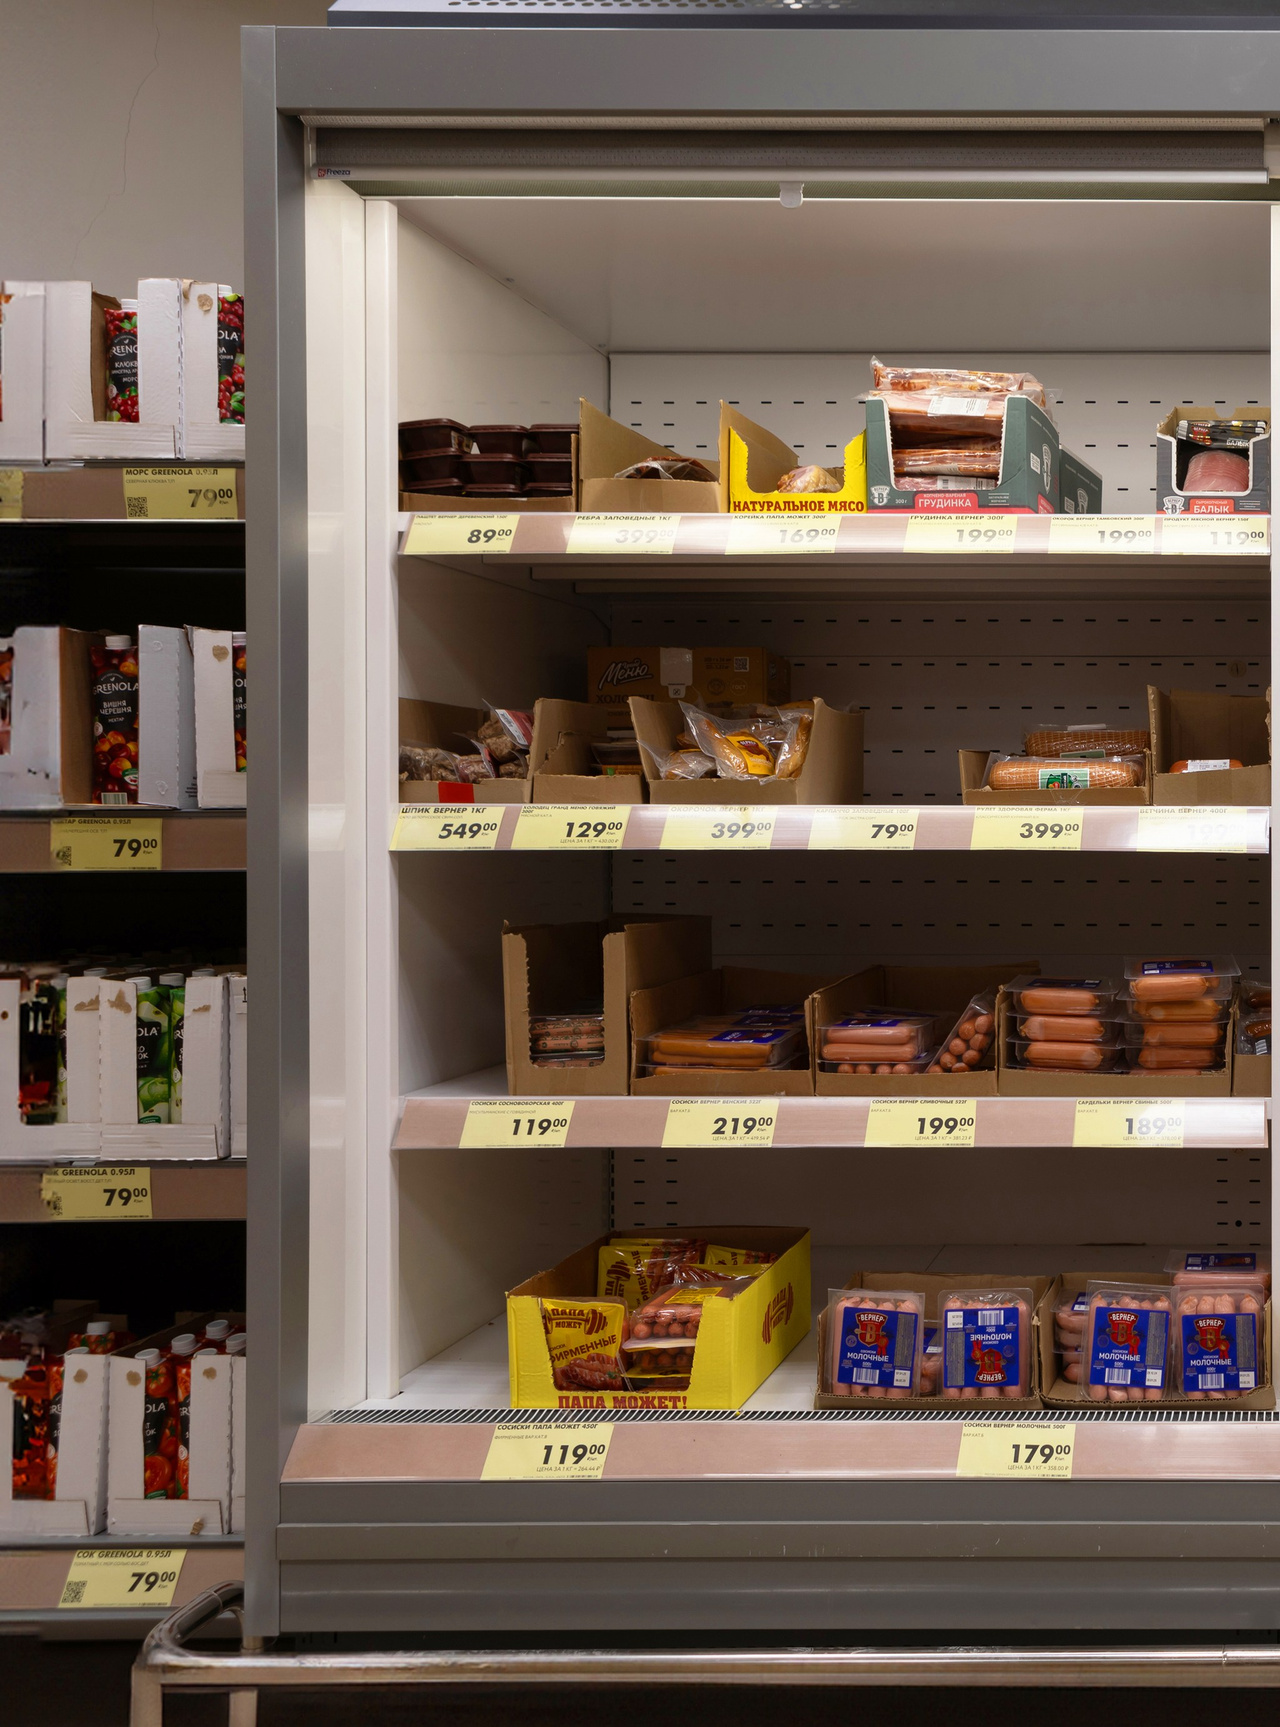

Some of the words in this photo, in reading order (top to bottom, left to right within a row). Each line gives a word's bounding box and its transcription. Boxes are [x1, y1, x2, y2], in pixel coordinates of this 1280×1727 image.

[733, 500, 825, 512] НАТУРАЛЬНОЕ
[828, 500, 864, 512] МЯСО
[918, 500, 972, 508] ГРУДИНКА
[1194, 506, 1230, 514] БАЛЫК
[551, 1308, 584, 1317] ПАПА
[860, 1314, 884, 1323] ВЕРНЕР
[1112, 1313, 1134, 1322] ВЕРНЕР
[554, 1320, 582, 1330] МОЖЕТ
[1198, 1319, 1222, 1328] ВЕРНЕР
[847, 1352, 889, 1362] МОЛОЧНЫЕ
[1098, 1352, 1141, 1362] МОЛОЧНЫЕ
[1190, 1358, 1232, 1366] МОЛОЧНЫЕ
[978, 1373, 1002, 1382] ВЕРНЕР
[558, 1396, 608, 1409] ПАПА
[613, 1396, 688, 1409] МОЖЕТ!
